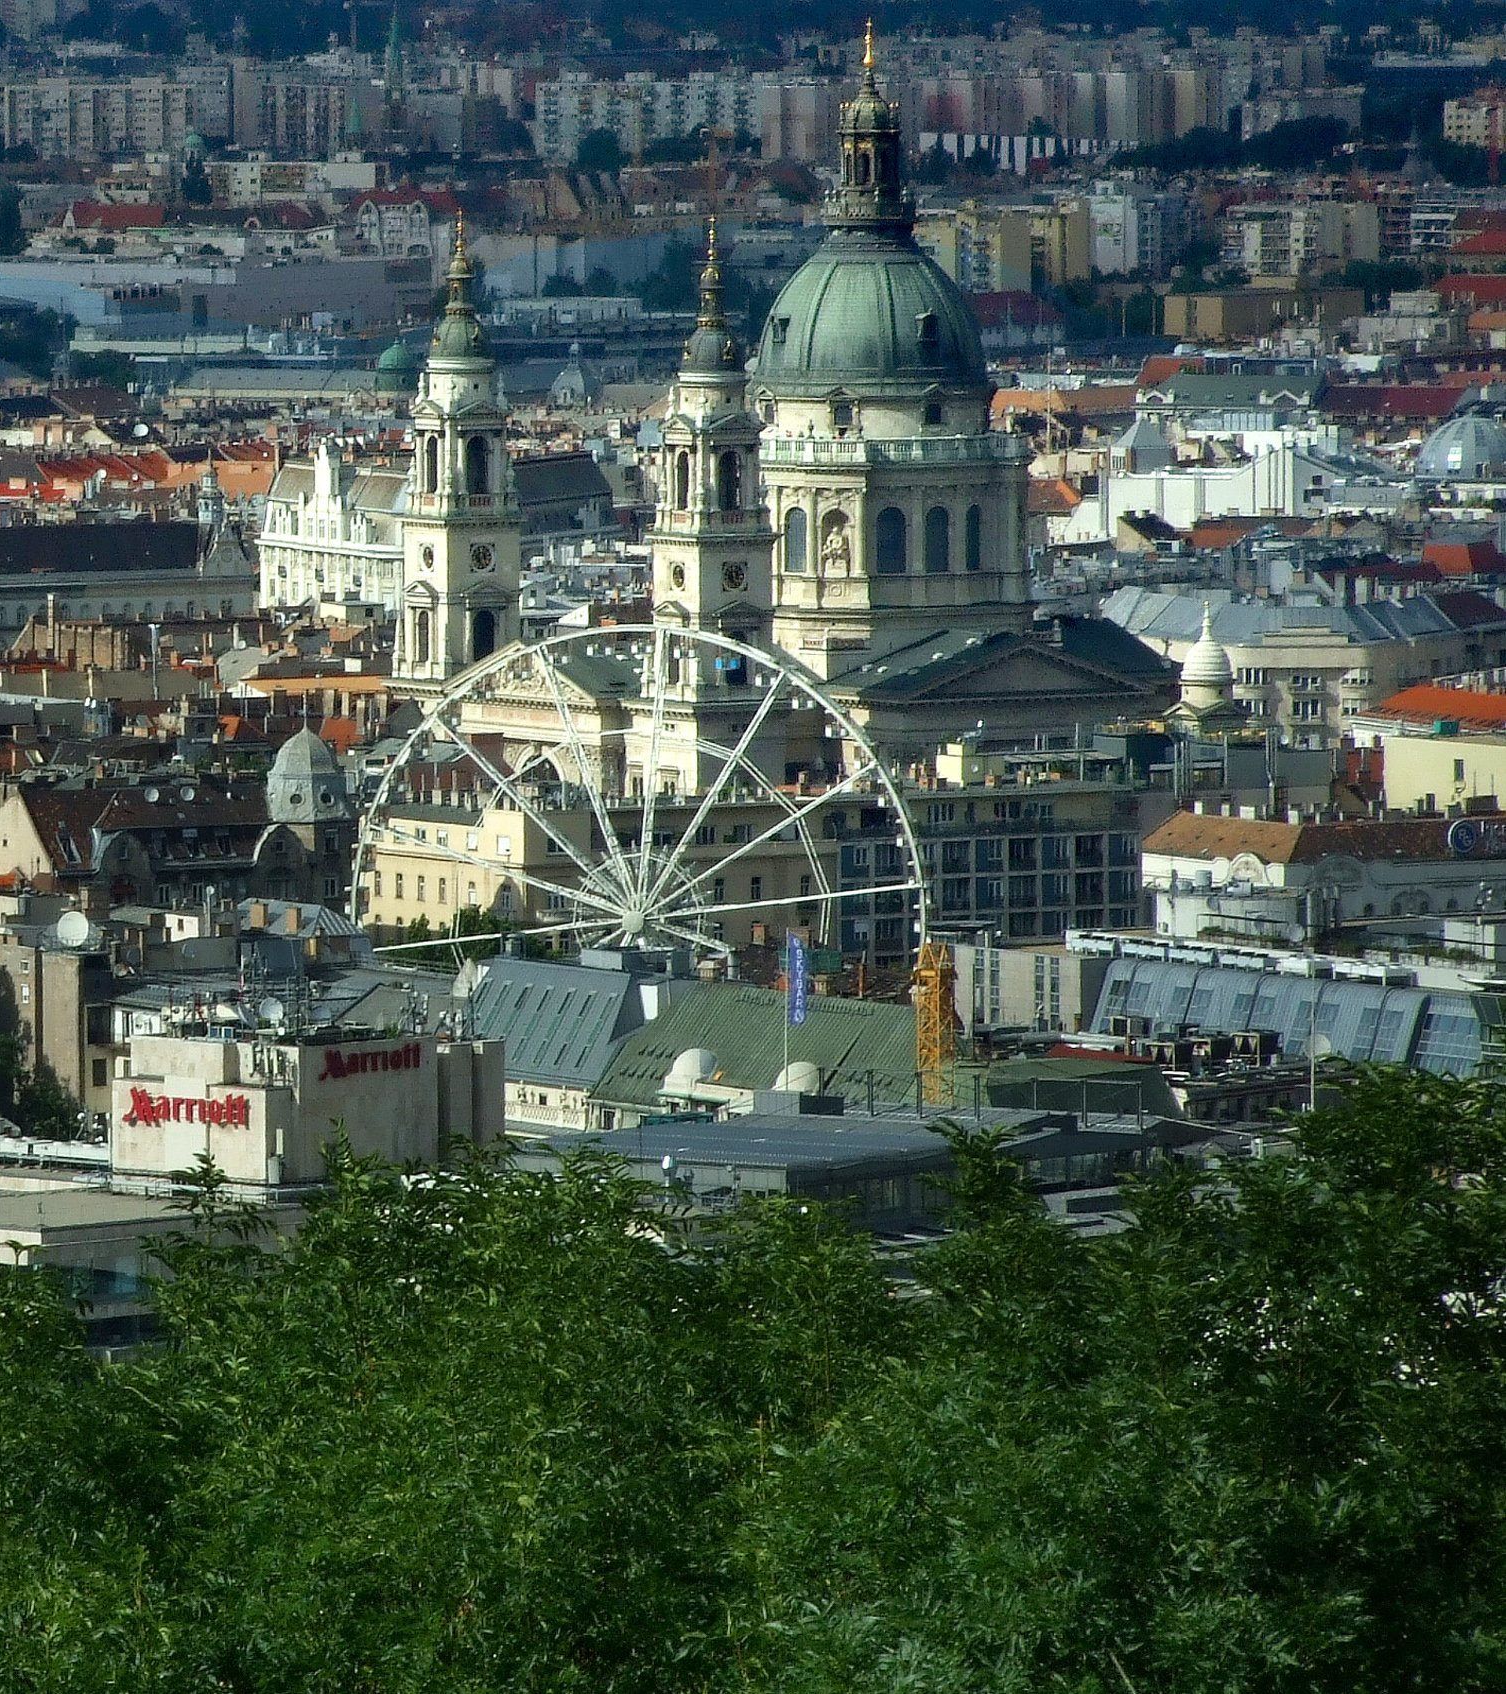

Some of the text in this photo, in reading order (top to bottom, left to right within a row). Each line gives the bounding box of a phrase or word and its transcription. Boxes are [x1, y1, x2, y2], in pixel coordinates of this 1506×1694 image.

[795, 948, 805, 1008] SKYBAR
[318, 1043, 420, 1081] Marriott
[122, 1086, 248, 1126] Marriott
